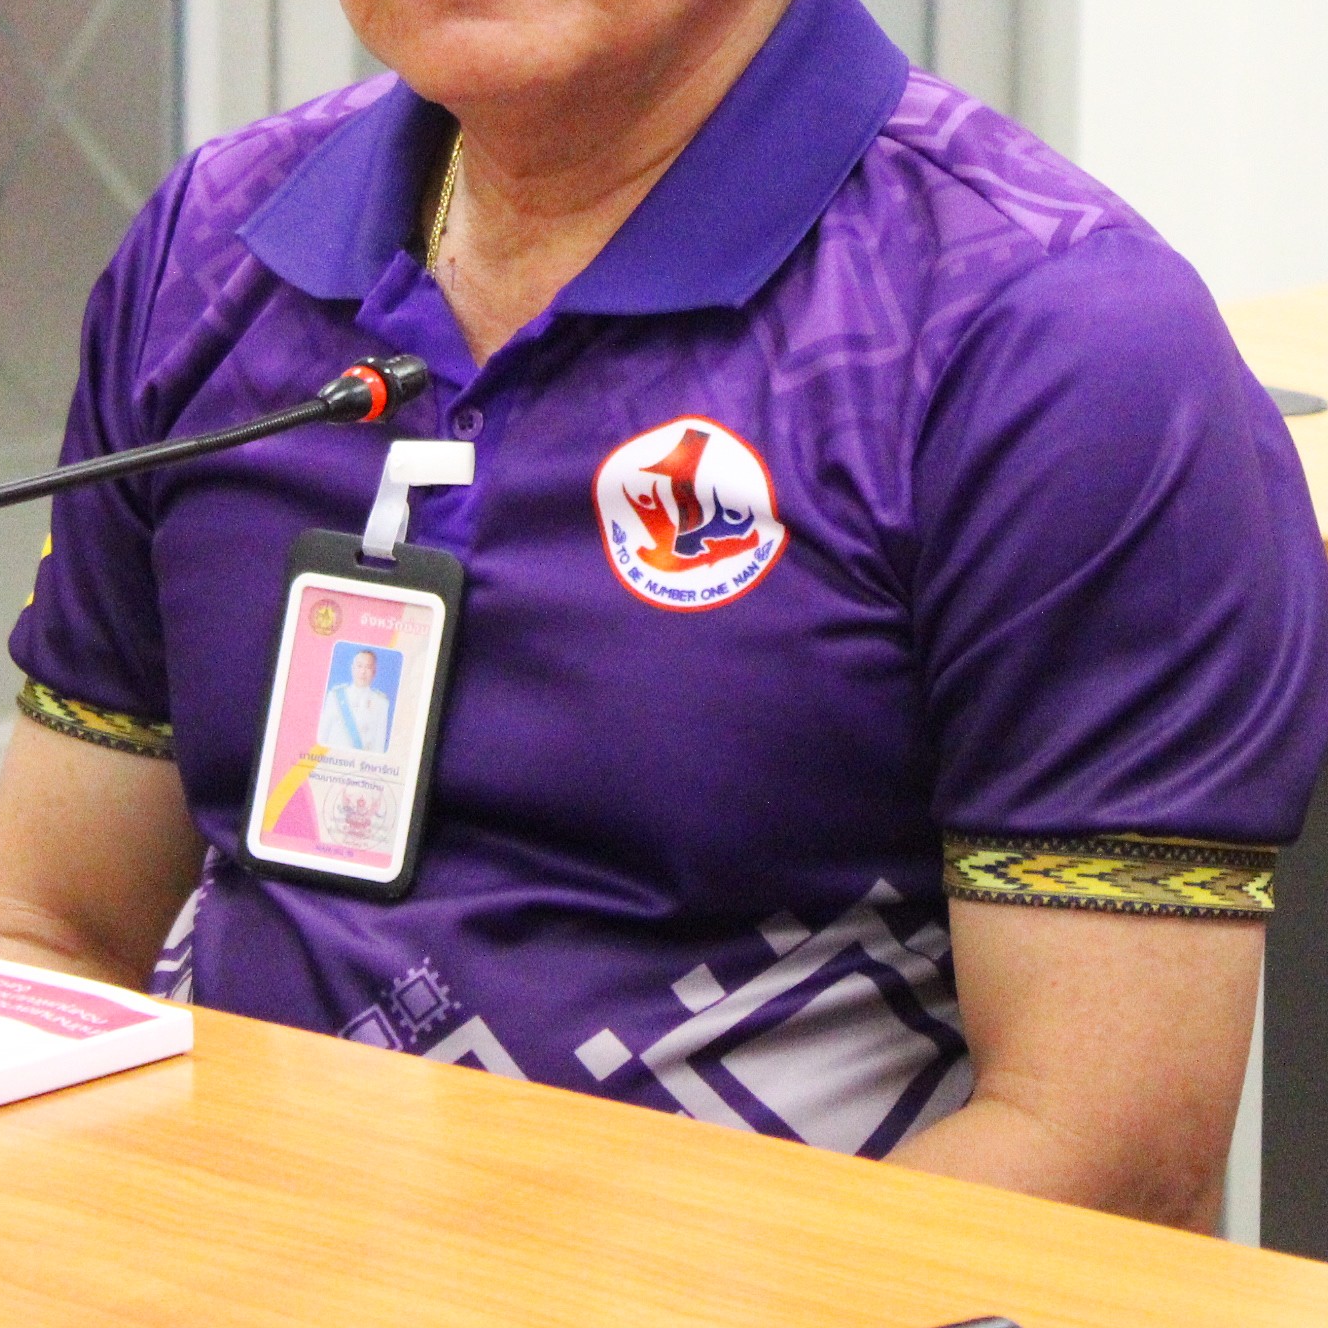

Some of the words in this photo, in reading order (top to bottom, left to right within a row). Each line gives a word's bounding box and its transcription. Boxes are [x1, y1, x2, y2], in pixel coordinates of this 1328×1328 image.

[616, 544, 631, 565] TO
[627, 566, 644, 583] BE
[644, 579, 697, 603] NUMBER
[700, 582, 729, 601] ONE
